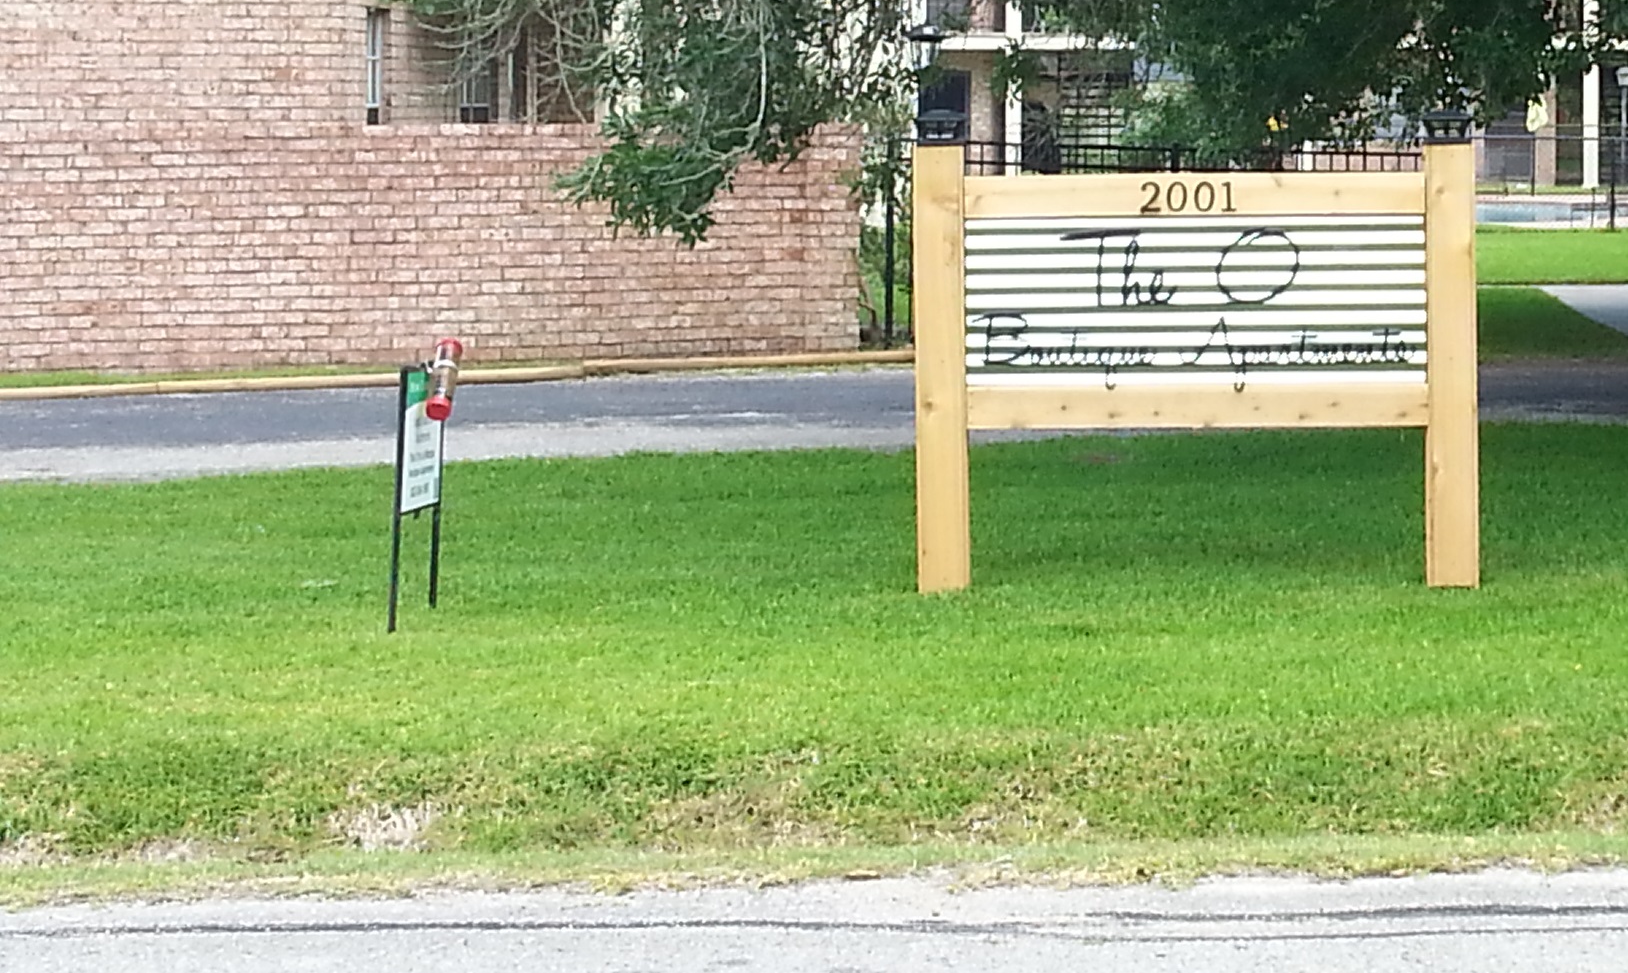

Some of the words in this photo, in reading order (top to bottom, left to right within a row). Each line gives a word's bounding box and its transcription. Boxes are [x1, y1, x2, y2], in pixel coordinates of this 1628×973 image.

[1140, 180, 1238, 214] 2001
[1059, 228, 1178, 307] The
[1215, 227, 1300, 304] O
[971, 311, 1158, 390] Boutique
[1178, 315, 1417, 393] Apartments
